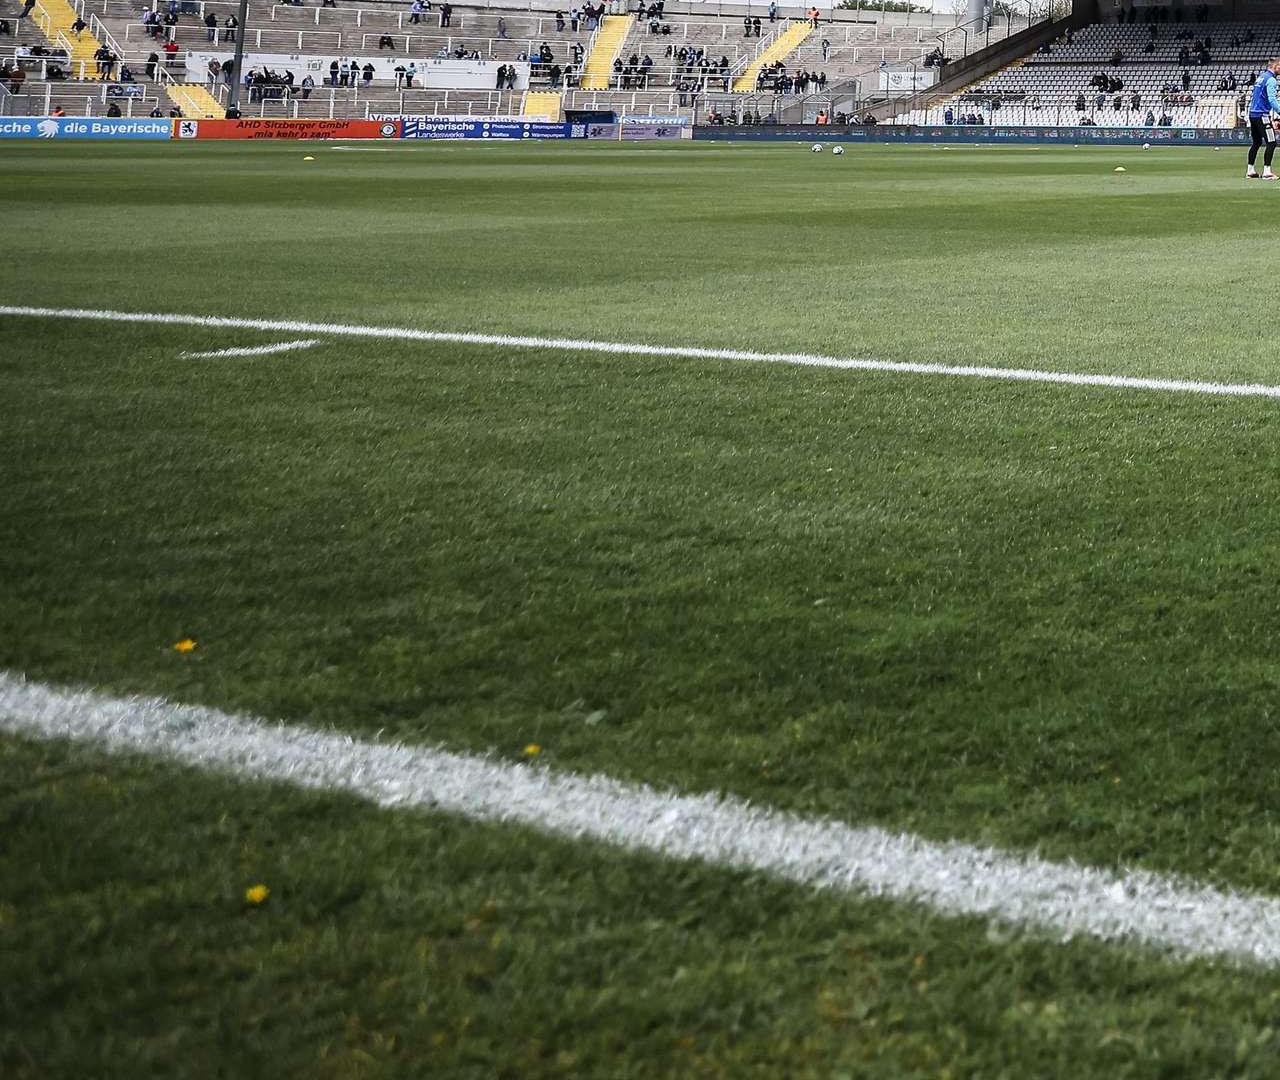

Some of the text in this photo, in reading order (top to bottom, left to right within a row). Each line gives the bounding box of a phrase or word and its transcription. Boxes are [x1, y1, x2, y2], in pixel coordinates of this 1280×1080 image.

[64, 122, 169, 134] die Bayerische
[236, 120, 350, 131] AHD Sitzberger GmbH
[418, 122, 475, 132] Bayerische
